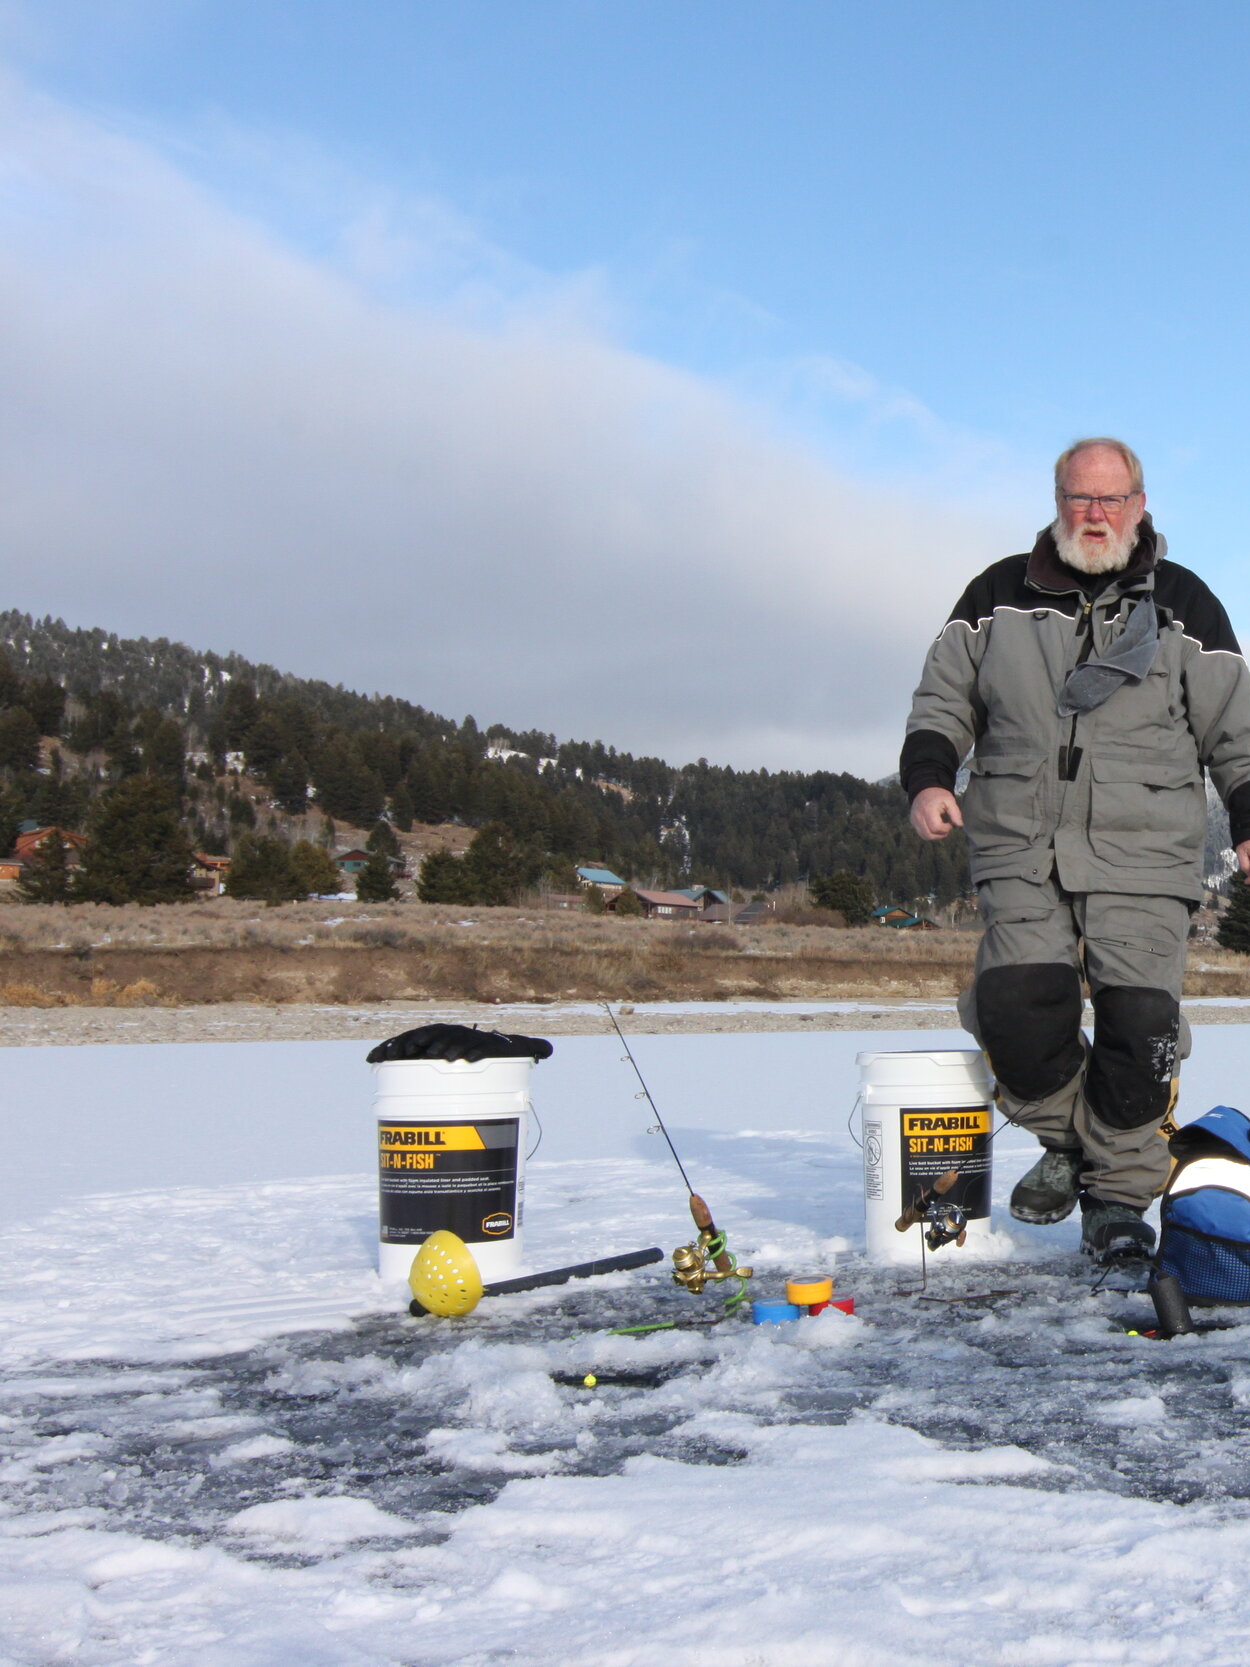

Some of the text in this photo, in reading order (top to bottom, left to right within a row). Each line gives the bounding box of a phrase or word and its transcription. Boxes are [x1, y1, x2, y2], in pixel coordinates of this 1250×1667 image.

[908, 1116, 980, 1131] FRABILL
[380, 1131, 446, 1146] FRABILL
[909, 1136, 973, 1153] SIT-N-FISH
[381, 1152, 434, 1169] SIT-N-FISH
[485, 1219, 510, 1229] FRABILL
